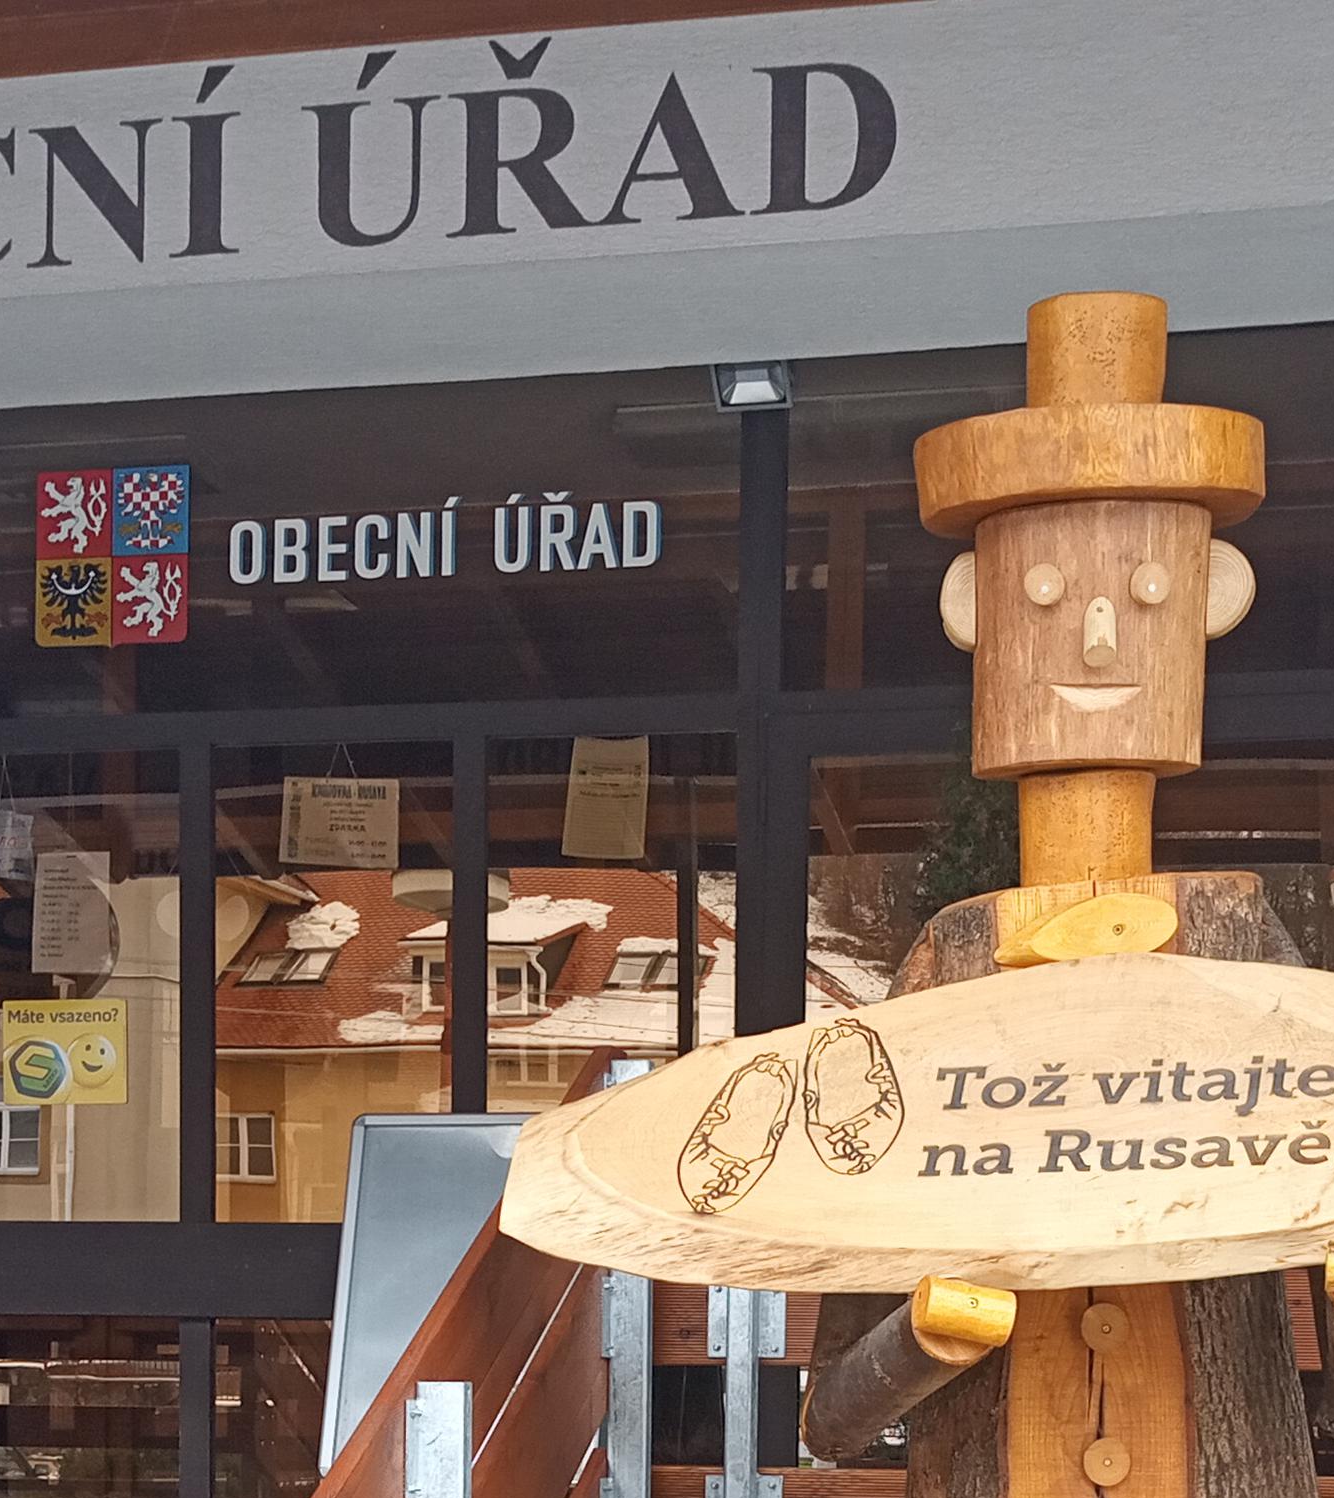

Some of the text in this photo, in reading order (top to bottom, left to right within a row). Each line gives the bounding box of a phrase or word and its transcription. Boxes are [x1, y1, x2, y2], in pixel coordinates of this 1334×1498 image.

[301, 36, 898, 247] ÚŘAD
[228, 490, 664, 585] OBECNÍ ÚŘAD
[7, 1008, 45, 1024] Máte
[50, 1007, 119, 1023] vsazeno?
[935, 1062, 1068, 1111] Tož
[917, 1142, 1015, 1178] na
